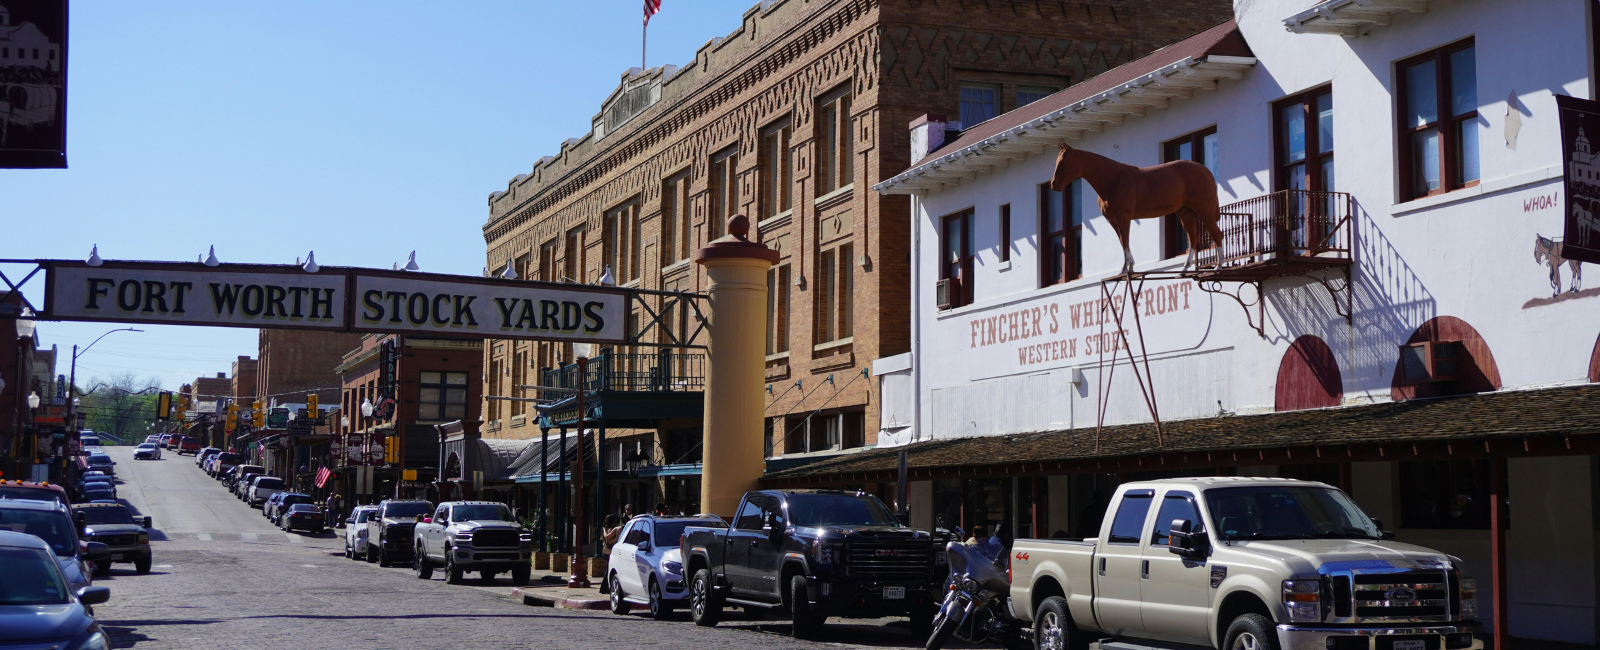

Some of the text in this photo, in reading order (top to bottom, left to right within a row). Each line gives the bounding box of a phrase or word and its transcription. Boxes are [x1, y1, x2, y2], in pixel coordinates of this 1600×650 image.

[1523, 191, 1558, 213] WHOA!
[83, 277, 605, 336] FORT WORTH STOCK YARDS
[970, 302, 1059, 349] FINCHER'S
[1018, 328, 1130, 366] WESTERN STORE
[874, 548, 909, 557] GMC
